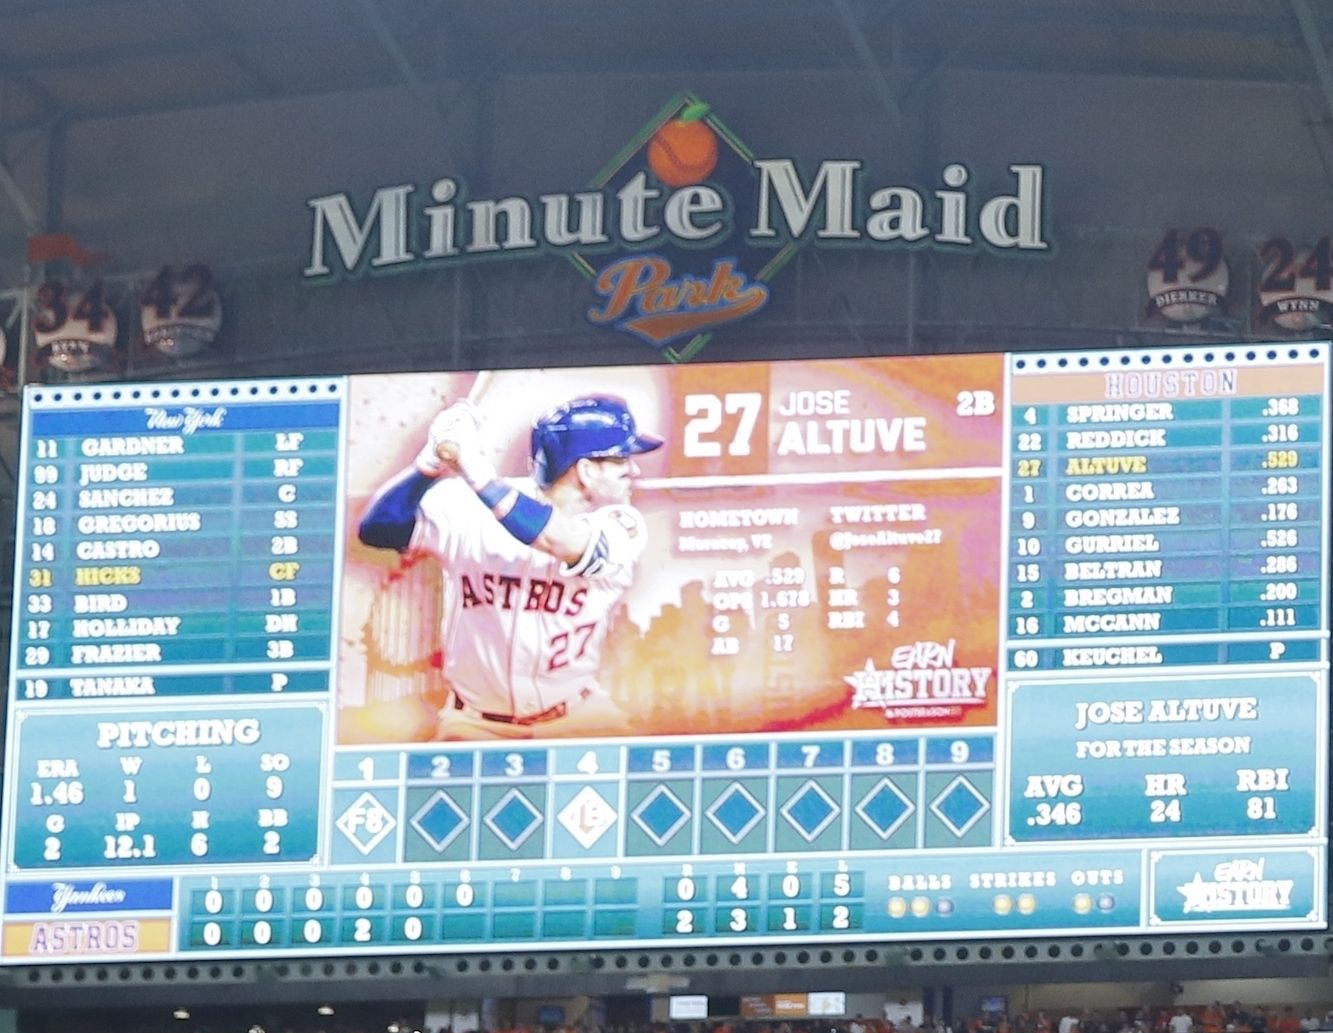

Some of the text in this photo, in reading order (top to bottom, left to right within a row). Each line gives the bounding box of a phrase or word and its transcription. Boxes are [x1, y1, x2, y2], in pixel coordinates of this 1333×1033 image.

[303, 158, 1047, 279] Minute Maid
[1148, 227, 1223, 284] 49
[588, 254, 768, 345] Park
[1277, 300, 1319, 312] WYNN
[1104, 369, 1238, 398] HOUSTON
[778, 389, 851, 416] JOSE
[956, 390, 995, 416] 2B
[1066, 403, 1174, 424] SPRINGER
[145, 406, 227, 434] New York
[684, 392, 761, 457] 27
[81, 435, 185, 456] GARDNER
[777, 417, 927, 456] ALTUVE
[1066, 429, 1167, 449] REDDICK
[79, 463, 148, 486] JUDGE
[1065, 456, 1147, 476] ALTUVE
[78, 487, 175, 508] SANCHEZ
[1065, 481, 1155, 502] CORREA
[77, 513, 201, 534] GREGORIUS
[679, 504, 926, 529] HOMETOWN TWITTER
[1065, 507, 1180, 528] GONZALEZ
[76, 539, 160, 560] CASTRO
[1065, 534, 1160, 554] GURRIEL
[74, 566, 141, 586] HICKS
[1064, 560, 1163, 580] BELTRAN
[73, 593, 128, 613] BIRD
[461, 573, 588, 617] ASTROS
[1063, 586, 1173, 607] BREGMAN
[72, 617, 182, 638] HOLLIDAY
[1063, 613, 1161, 634] MCCANN
[70, 643, 162, 664] FRAZIER
[547, 622, 598, 672] 27
[891, 639, 955, 668] EARN
[1062, 646, 1163, 666] KEUCHEL
[69, 677, 155, 697] TANAKA
[850, 663, 992, 709] HISTORY
[1075, 697, 1258, 730] JOSE ALTUVE
[97, 718, 260, 748] PITCHING
[1075, 736, 1251, 758] FOR THE SEASON
[37, 759, 80, 778] ERA
[29, 782, 85, 806] 1.46
[1024, 768, 1289, 798] AVG HR RBI
[1027, 797, 1277, 826] .346 24 81
[104, 834, 157, 860] 12.1
[888, 871, 1056, 891] BALLS STRIKES
[1071, 869, 1124, 886] OUTS
[50, 882, 127, 913] Yankees
[32, 920, 139, 954] ASTROS
